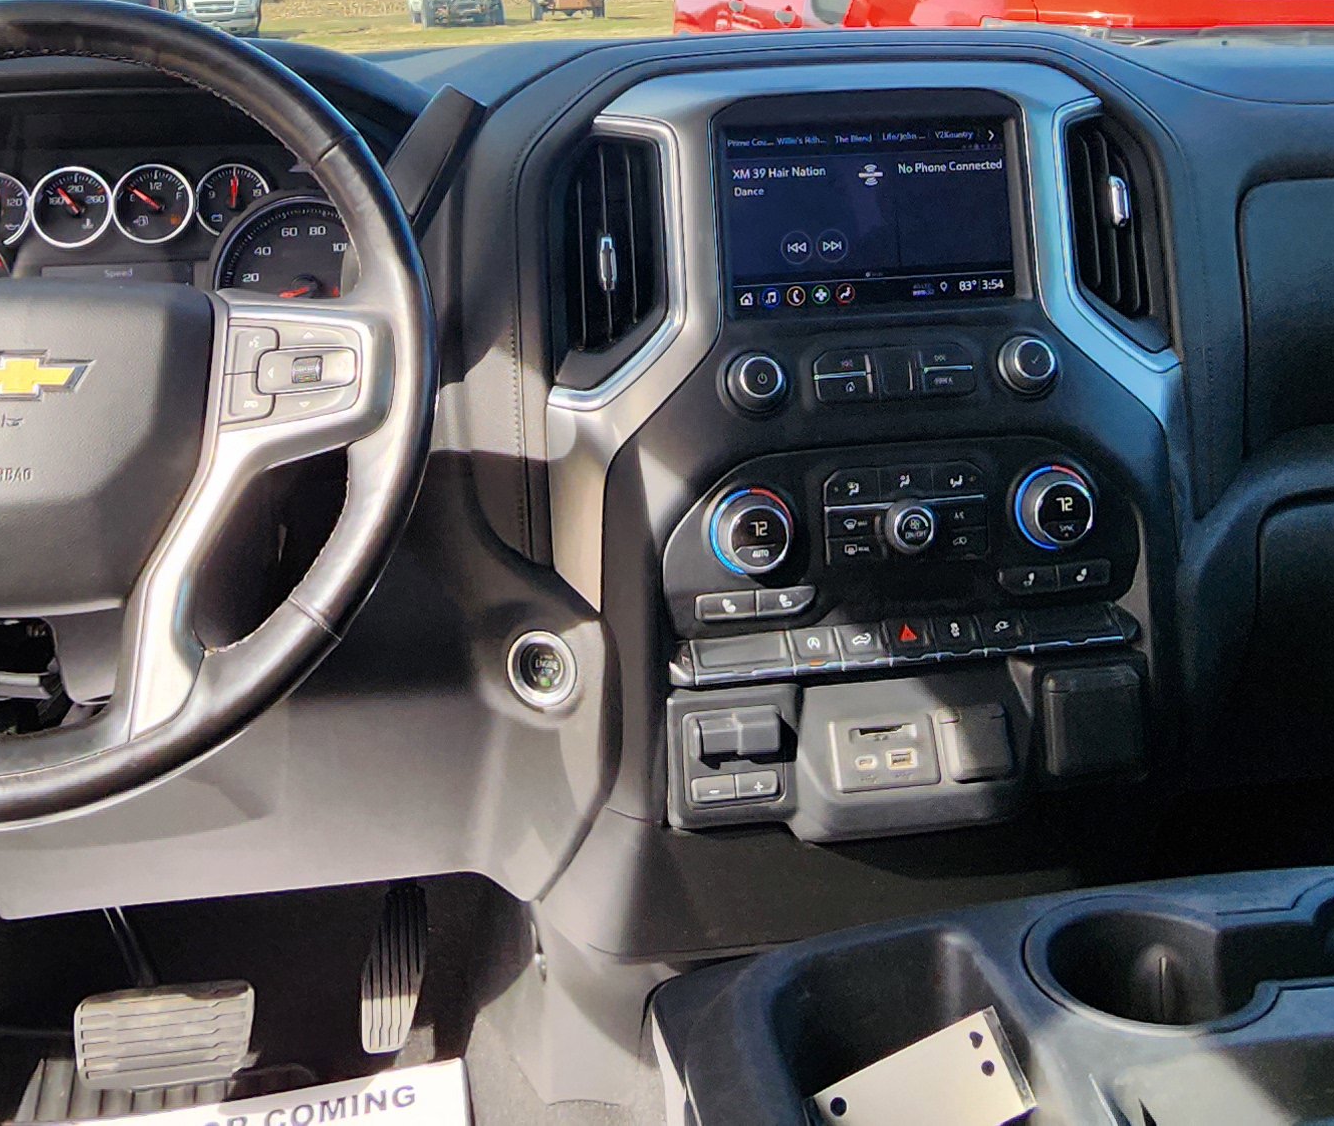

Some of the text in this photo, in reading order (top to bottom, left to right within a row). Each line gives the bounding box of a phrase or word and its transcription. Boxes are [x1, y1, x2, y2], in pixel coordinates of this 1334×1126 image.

[835, 135, 849, 144] The
[898, 159, 1003, 174] No Phone Connected
[732, 166, 826, 180] XM 39 Hair Nation
[67, 184, 84, 194] 210
[86, 194, 105, 204] 260
[149, 181, 162, 191] 1/2
[175, 191, 182, 201] F
[734, 187, 764, 197] Dance
[6, 198, 23, 208] 120
[281, 227, 298, 237] 60
[309, 226, 326, 236] 80
[254, 246, 272, 256] 40
[242, 273, 260, 283] 20
[982, 278, 1004, 290] 3:54
[1056, 496, 1073, 512] 72
[750, 521, 768, 537] 72
[264, 1085, 416, 1126] COMING
